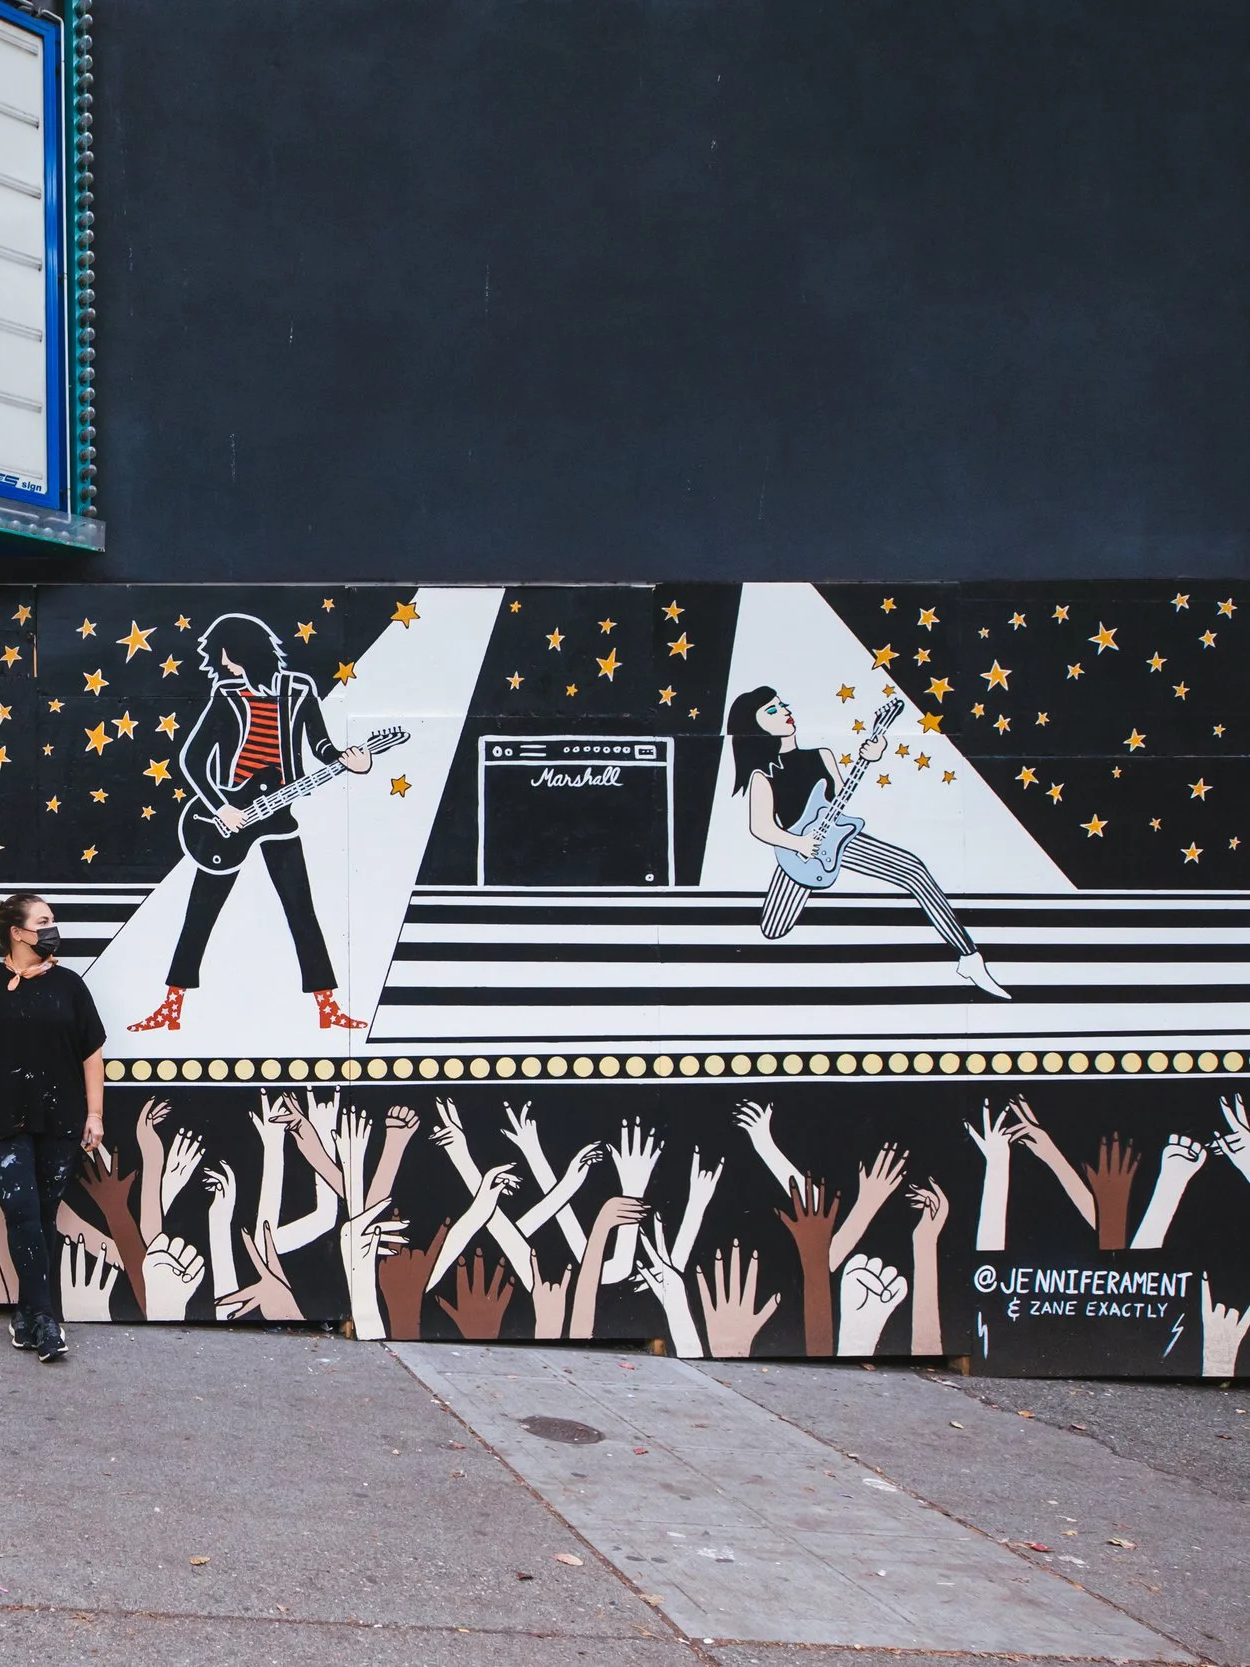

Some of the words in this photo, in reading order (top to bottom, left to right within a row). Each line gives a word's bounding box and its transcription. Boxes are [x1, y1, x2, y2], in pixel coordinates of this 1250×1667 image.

[530, 766, 624, 788] Marshall
[973, 1264, 1193, 1298] @JENNIFERAMENT
[1029, 1300, 1078, 1317] ZANE
[1085, 1301, 1168, 1319] EXACTLY
